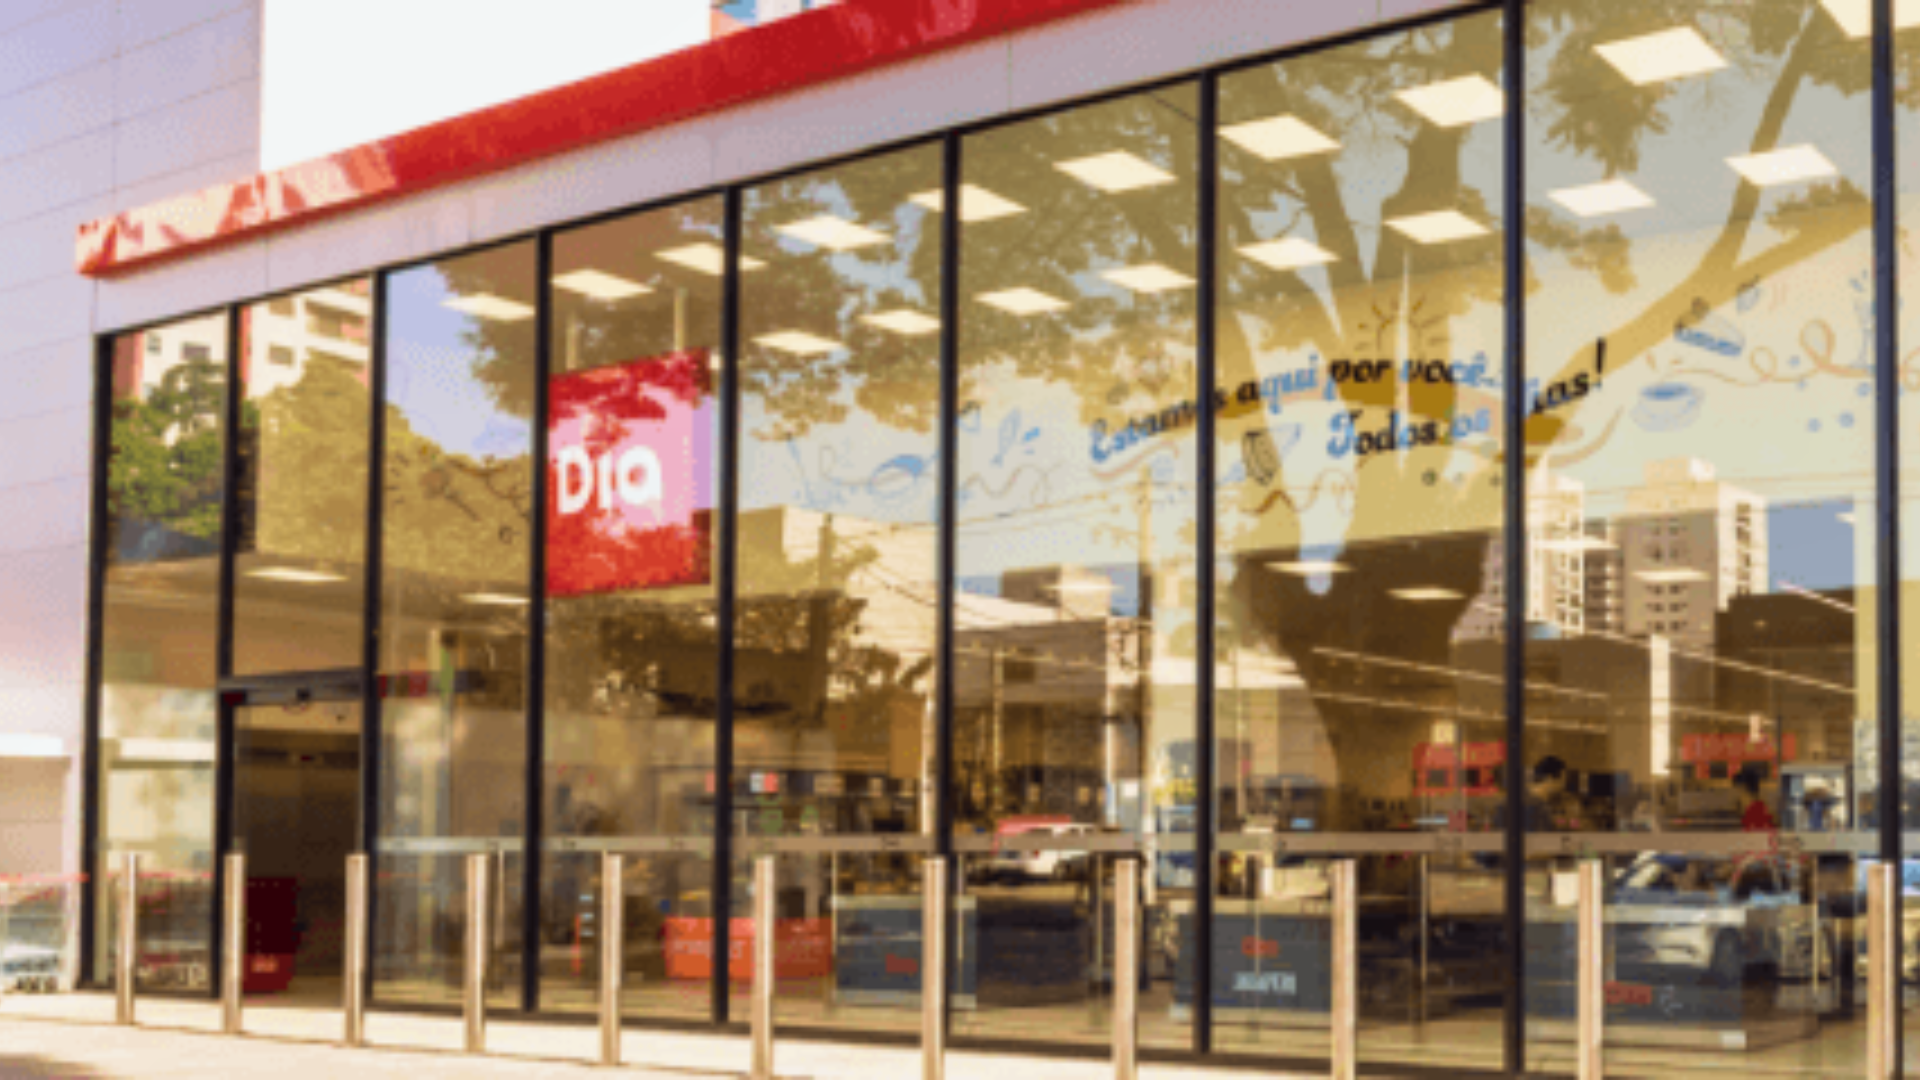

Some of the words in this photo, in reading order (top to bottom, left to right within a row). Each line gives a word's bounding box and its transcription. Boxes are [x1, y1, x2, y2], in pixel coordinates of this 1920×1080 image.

[1089, 388, 1226, 463] Estams
[1236, 353, 1318, 416] aqui
[1323, 358, 1394, 402] por
[1326, 408, 1436, 460] Todos
[1451, 408, 1489, 439] os
